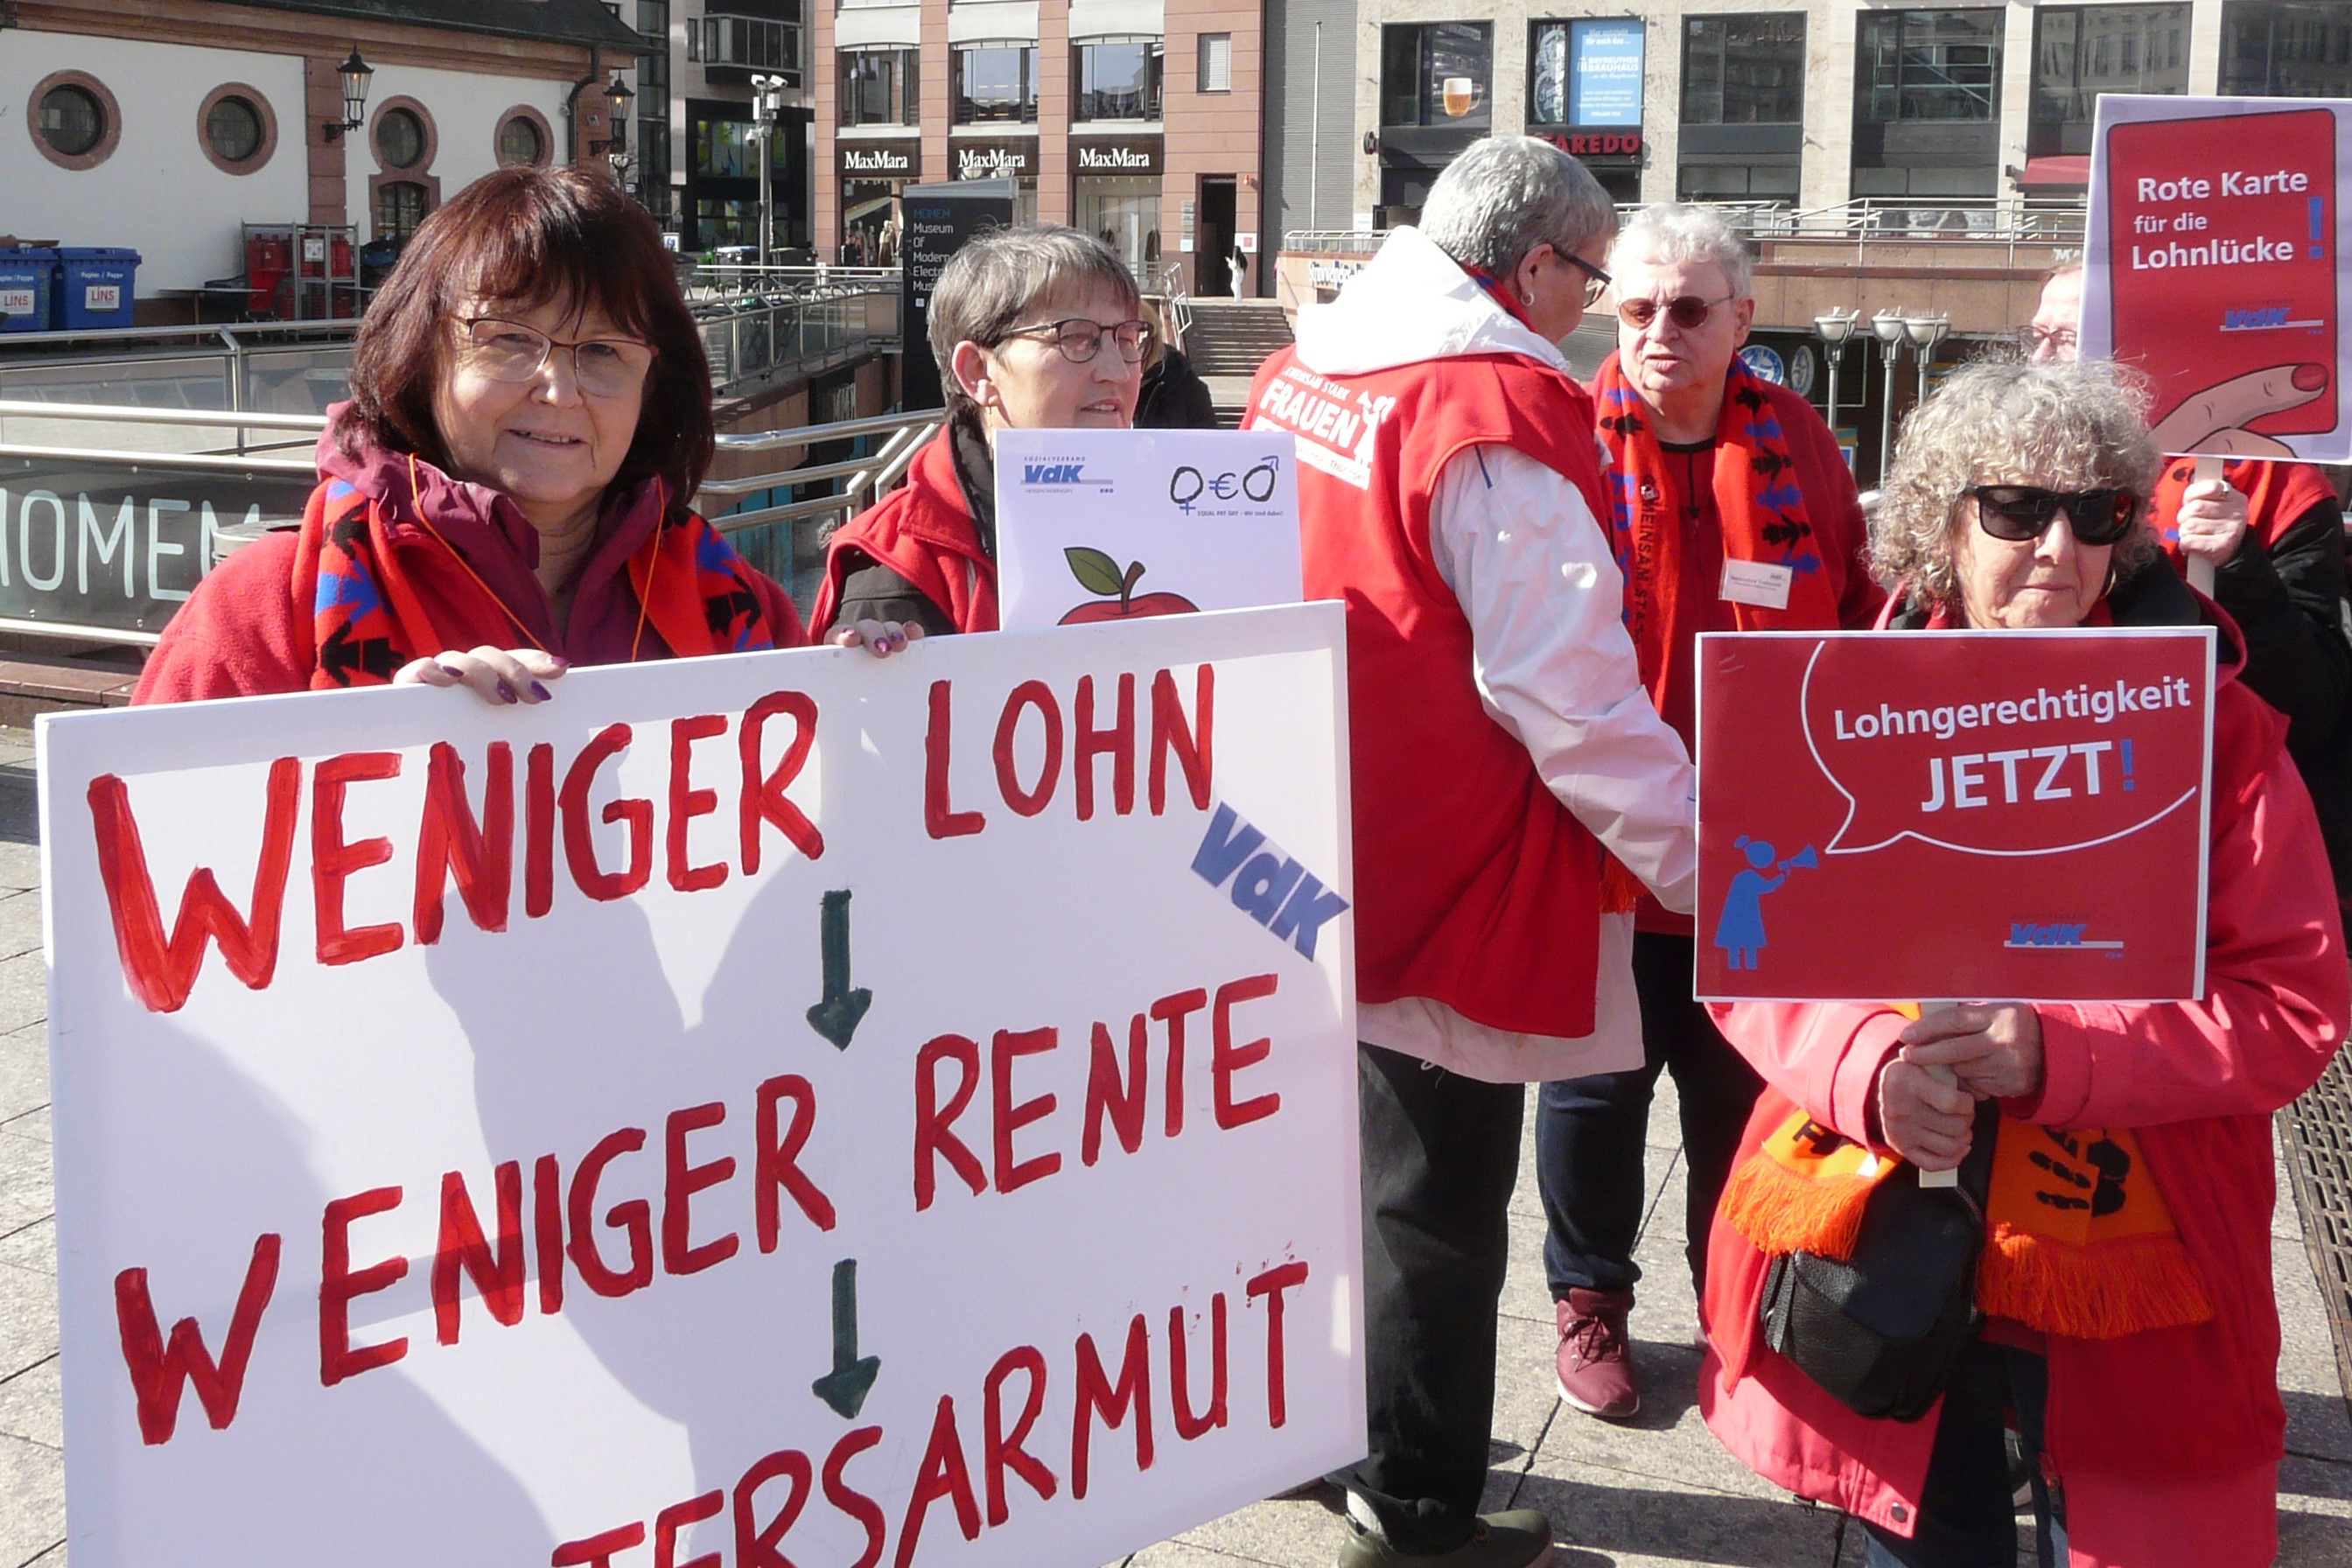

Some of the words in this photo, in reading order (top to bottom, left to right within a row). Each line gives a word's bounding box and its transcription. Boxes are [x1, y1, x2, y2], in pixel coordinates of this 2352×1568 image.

[844, 151, 908, 169] MaxMara
[958, 149, 1026, 168] MaxMara
[1078, 149, 1150, 167] MaxMara
[2138, 177, 2210, 202] Rote
[2221, 170, 2308, 197] Karte
[914, 222, 954, 234] Museum
[2133, 214, 2167, 234] für
[2174, 212, 2208, 231] die
[914, 236, 925, 248] Of
[2132, 235, 2293, 270] Lohnlücke
[914, 251, 950, 262] Modern
[914, 265, 944, 277] Electr
[2225, 306, 2290, 328] VdK
[1321, 381, 1351, 401] STARK
[1259, 378, 1361, 449] FRAUEN
[1024, 464, 1084, 483] VdK
[1634, 473, 1656, 584] GMEINSAM
[1835, 676, 2191, 740] Lohngerechtigkeit
[88, 691, 824, 1013] WENIGER
[925, 663, 1214, 838] LOHN
[1191, 802, 1350, 961] VdK
[2010, 923, 2088, 945] VdK
[116, 1075, 836, 1446] WENIGER
[914, 974, 1280, 1211] RENTE
